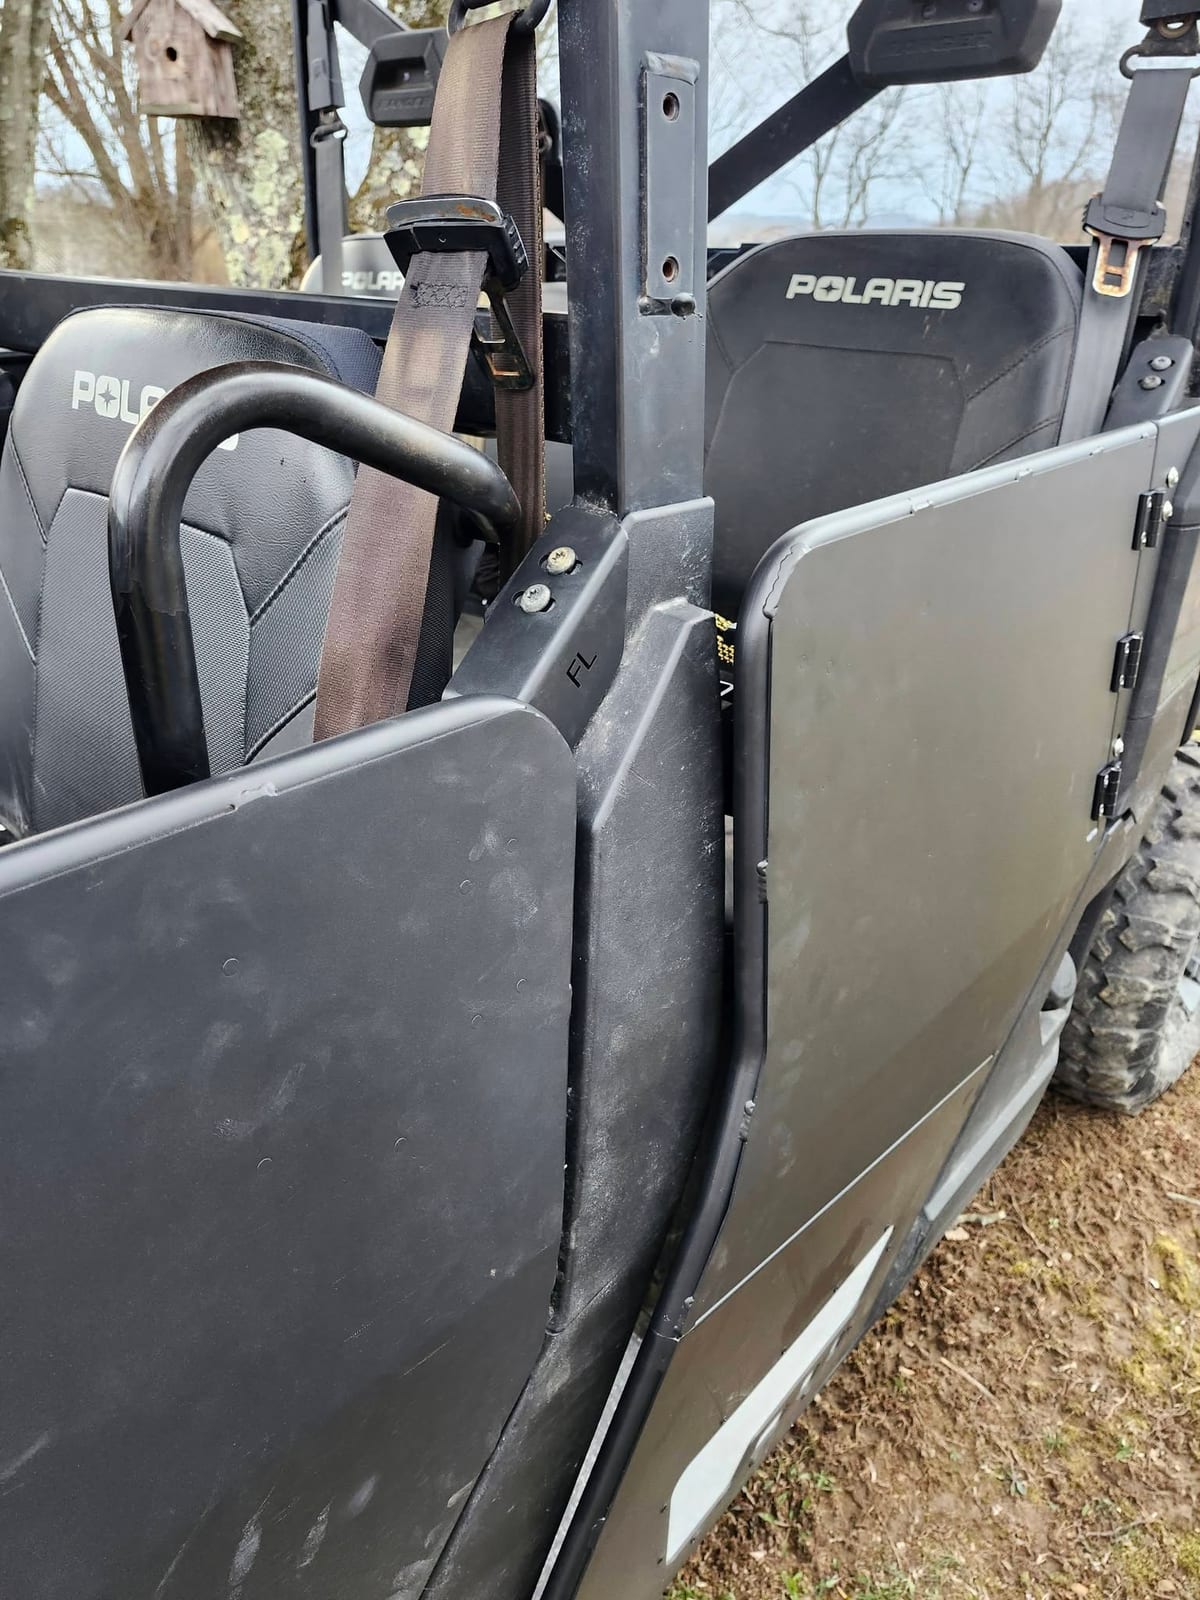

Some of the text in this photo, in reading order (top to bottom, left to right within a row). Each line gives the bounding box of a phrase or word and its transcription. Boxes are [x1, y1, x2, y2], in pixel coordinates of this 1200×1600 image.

[341, 271, 404, 290] POLAR
[786, 273, 966, 310] POLARIS
[566, 652, 597, 689] FL
